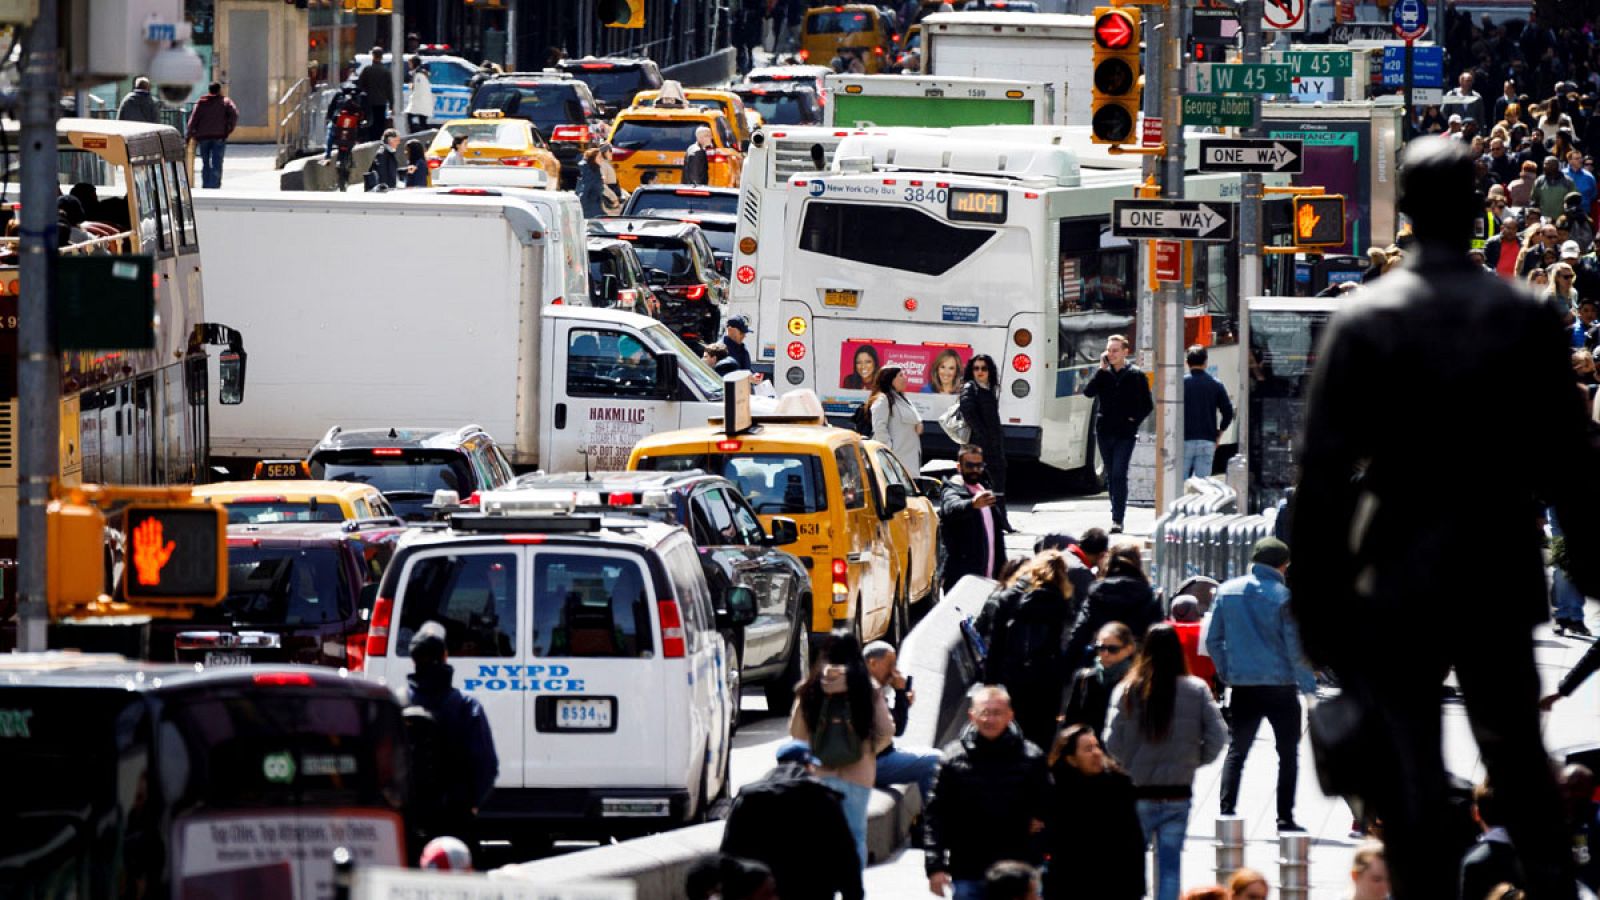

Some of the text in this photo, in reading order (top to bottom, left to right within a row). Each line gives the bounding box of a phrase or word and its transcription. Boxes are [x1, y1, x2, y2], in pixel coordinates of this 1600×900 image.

[1287, 54, 1350, 74] W 45 St
[1216, 67, 1289, 90] W 45 St
[1184, 99, 1251, 119] George Abbott
[1213, 149, 1288, 163] ONE WAY
[827, 183, 842, 193] New
[844, 184, 863, 195] York
[864, 186, 879, 197] City
[881, 187, 896, 195] Bus
[903, 187, 948, 204] 3840
[1130, 211, 1216, 228] ONE WAY
[590, 407, 625, 421] HAKMI
[588, 445, 598, 456] US
[600, 446, 613, 457] DOT
[267, 464, 296, 477] 5E28
[478, 664, 570, 678] NYPD
[464, 679, 585, 692] POLICE
[561, 705, 596, 722] 8534
